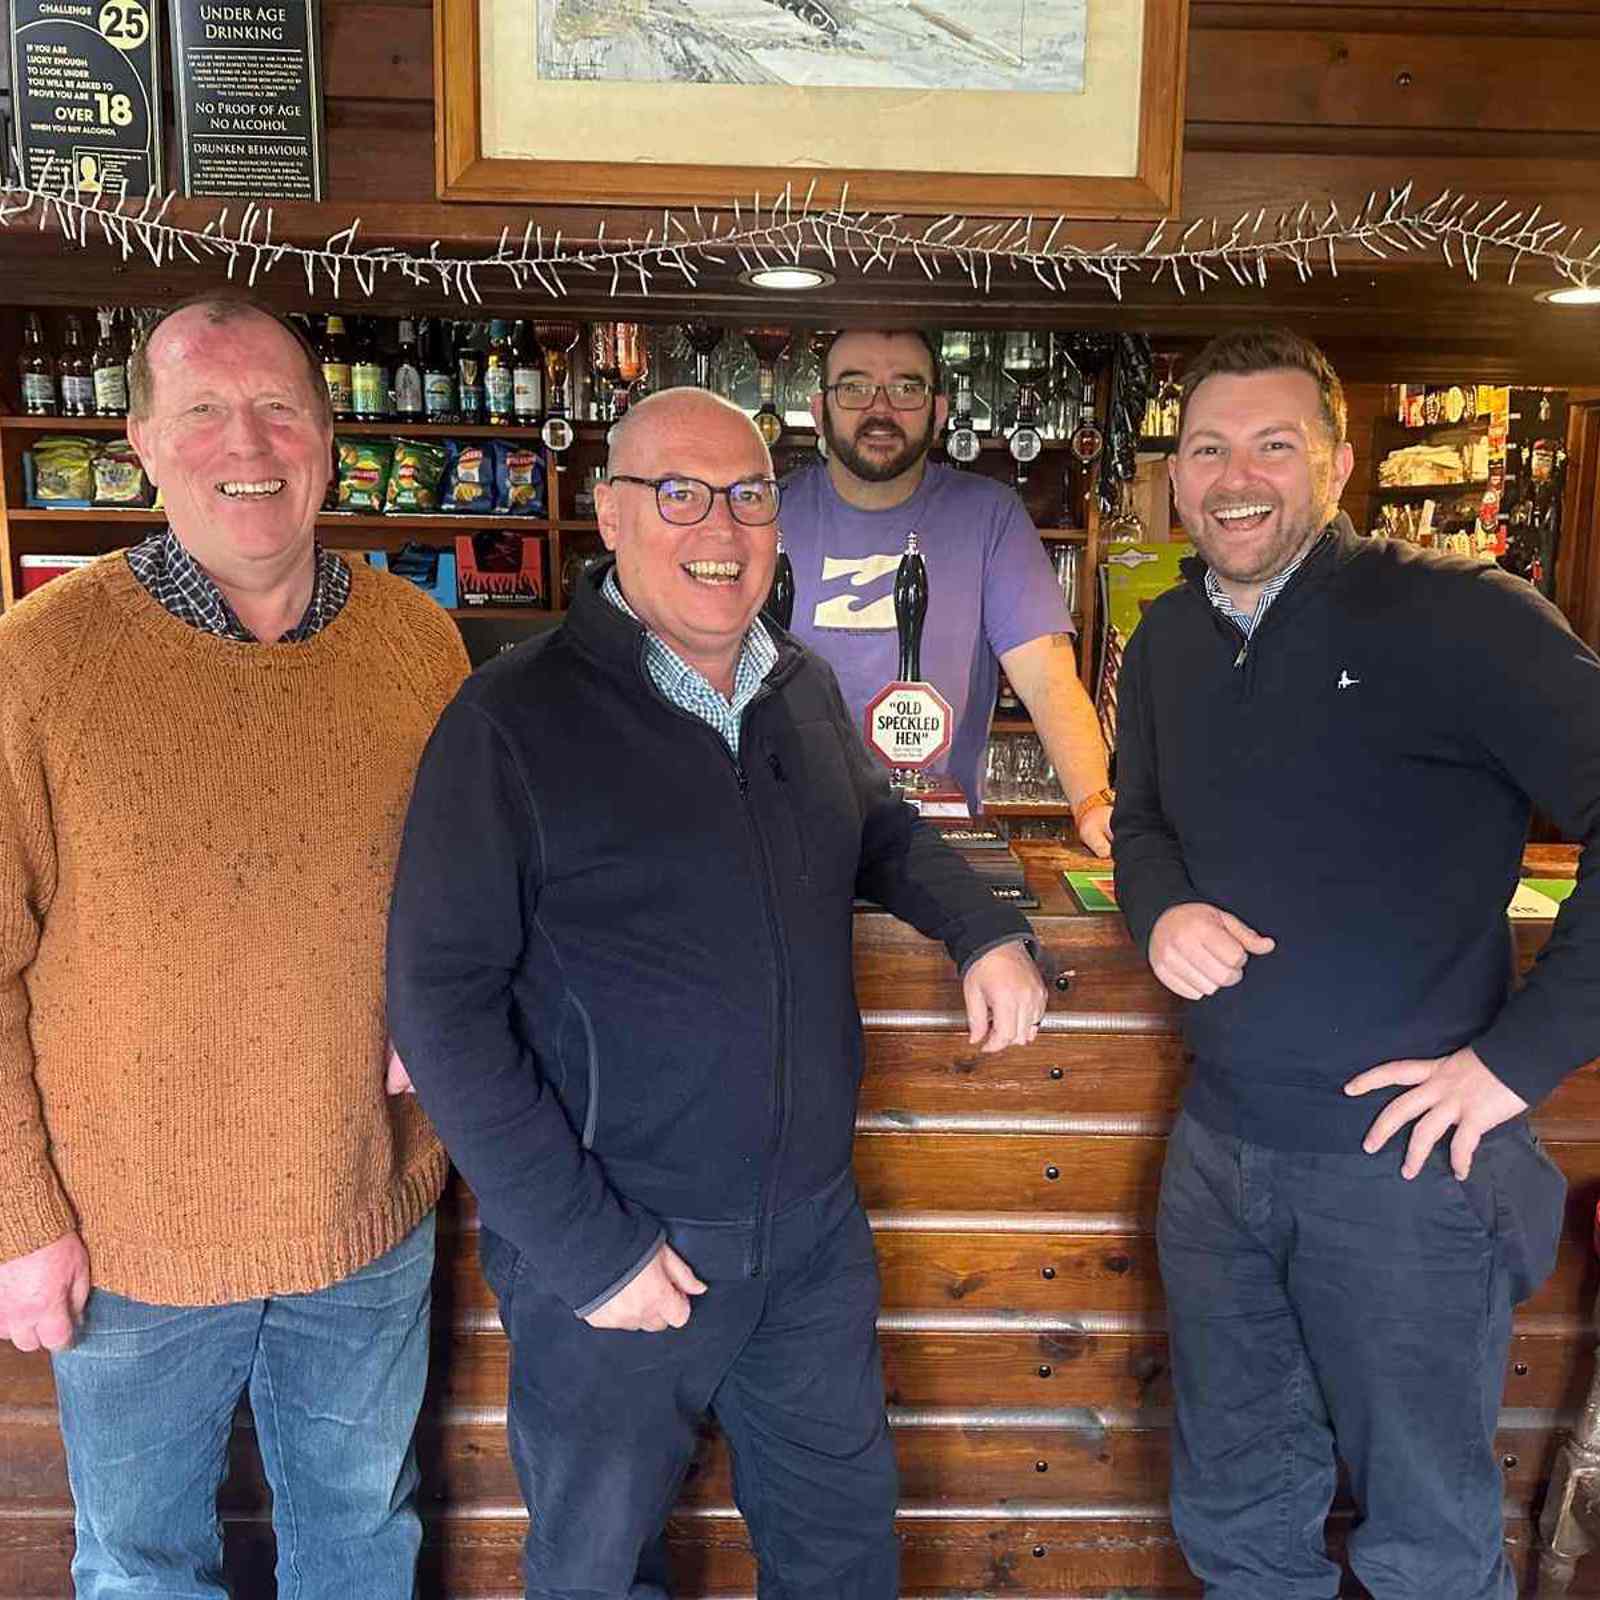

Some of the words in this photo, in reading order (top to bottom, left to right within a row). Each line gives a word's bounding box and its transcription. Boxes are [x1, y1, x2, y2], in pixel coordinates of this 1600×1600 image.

[200, 5, 251, 21] UNDER
[256, 8, 286, 22] AGE
[38, 3, 92, 15] CHALLENGE
[104, 6, 144, 39] 25
[205, 24, 283, 40] DRINKING
[34, 44, 50, 53] YOU
[51, 45, 67, 55] ARE
[27, 55, 53, 65] LUCKY
[54, 57, 88, 67] ENOUGH
[27, 66, 39, 76] TO
[40, 67, 63, 77] LOOK
[63, 69, 89, 78] UNDER
[28, 78, 45, 87] YOU
[46, 79, 64, 89] WILL
[65, 80, 75, 89] BE
[76, 81, 101, 91] ASKED
[102, 83, 113, 92] TO
[29, 89, 54, 99] PROVE
[55, 91, 72, 100] YOU
[73, 92, 89, 101] ARE
[55, 106, 94, 122] OVER
[95, 93, 133, 126] 18
[195, 103, 214, 114] NO
[218, 103, 257, 115] PROOF
[259, 105, 274, 115] OF
[278, 105, 302, 116] AGE
[51, 124, 67, 133] YOU
[82, 126, 116, 137] ALCOHOL
[210, 118, 230, 129] NO
[232, 119, 287, 131] ALCOHOL
[193, 143, 245, 155] DRUNKEN
[248, 144, 308, 157] BEHAVIOUR
[889, 701, 922, 716] "OLD
[878, 716, 940, 731] SPECKLED
[895, 732, 929, 745] HEN"
